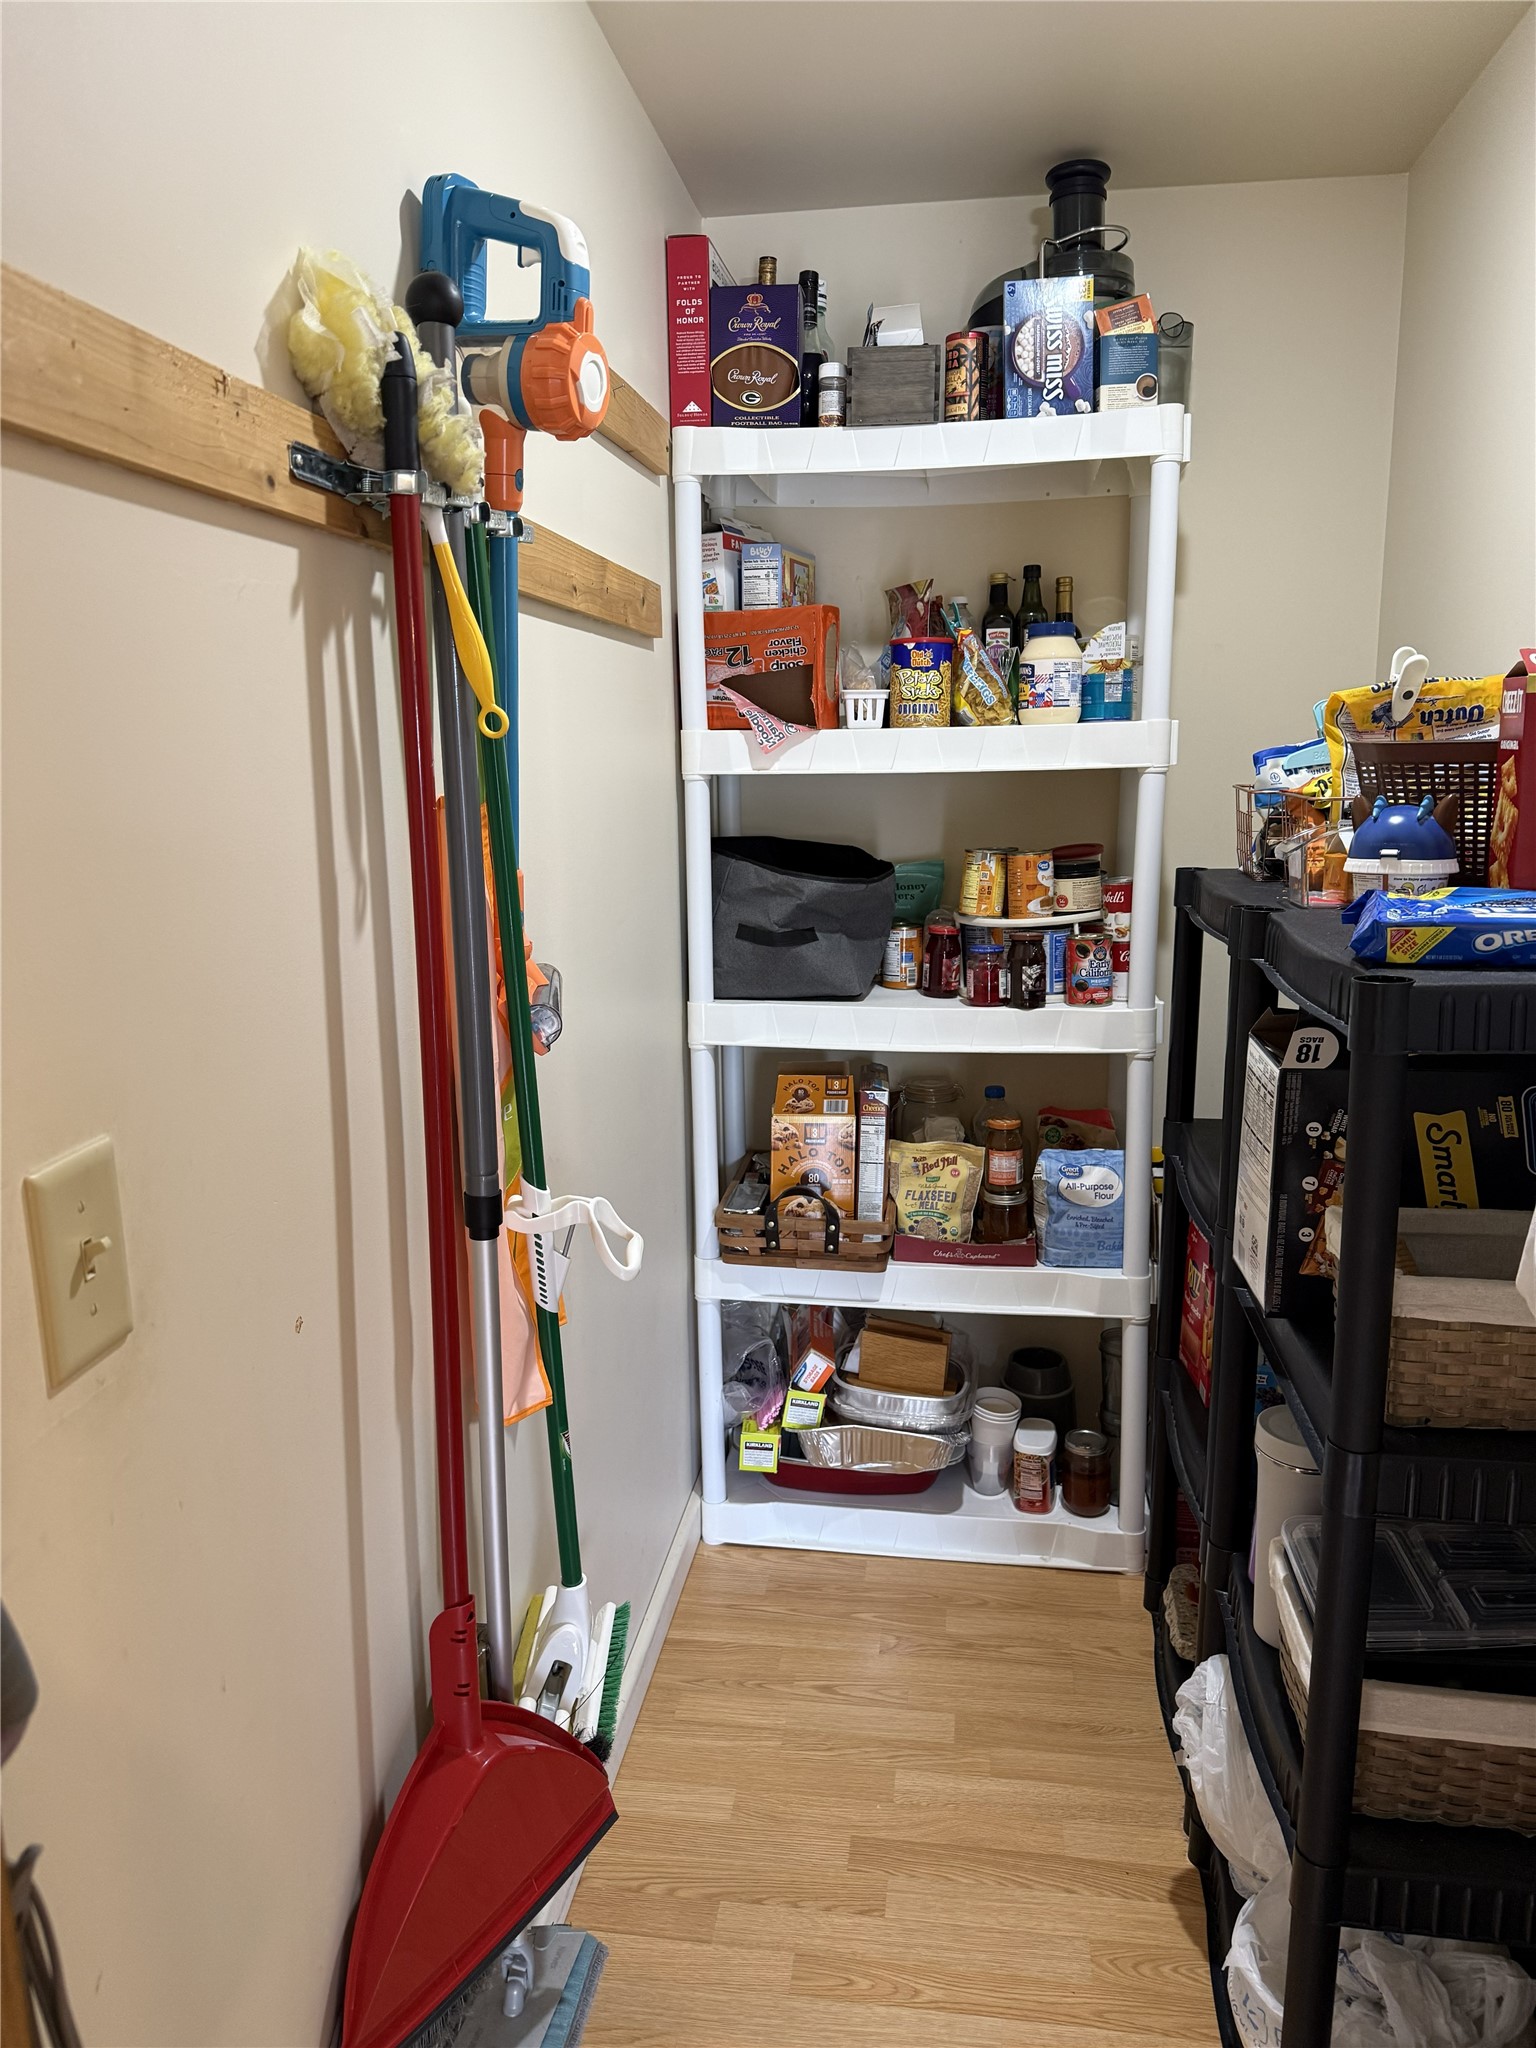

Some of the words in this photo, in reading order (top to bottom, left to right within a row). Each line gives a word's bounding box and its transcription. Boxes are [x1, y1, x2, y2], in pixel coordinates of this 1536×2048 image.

[676, 298, 703, 307] FOLDS
[685, 307, 696, 315] OF
[676, 316, 705, 325] HONOR
[728, 316, 753, 333] Crown
[745, 315, 781, 332] Royal
[1044, 294, 1064, 352] SWISS
[727, 368, 751, 383] Crown
[745, 370, 779, 386] Royal
[1042, 353, 1064, 401] MISS
[749, 545, 773, 558] BLUEY
[768, 636, 802, 647] Flavor
[725, 643, 754, 668] 12
[764, 646, 807, 658] Chicken
[910, 649, 925, 659] Old
[910, 658, 932, 667] Dutch
[896, 668, 943, 686] Potato
[901, 683, 943, 701] Sticks
[898, 703, 940, 715] ORIGINAL
[1420, 703, 1485, 726] Dutch
[1390, 930, 1418, 955] FAMILY
[1474, 929, 1536, 952] ORE
[1401, 940, 1419, 955] SIZE
[1088, 959, 1111, 969] Early
[1299, 1036, 1325, 1044] BAGS
[1295, 1043, 1323, 1064] 18
[783, 1078, 804, 1092] HALO
[807, 1079, 820, 1092] TOP
[833, 1080, 839, 1089] 3
[862, 1103, 886, 1112] Cheerios
[1500, 1100, 1513, 1112] 80
[1331, 1108, 1344, 1134] CHEDDAR
[1488, 1113, 1497, 1123] NO
[812, 1127, 818, 1138] 3
[777, 1147, 819, 1175] HALO
[827, 1150, 851, 1175] TOP
[921, 1161, 940, 1176] Red
[940, 1155, 958, 1171] Mill
[1426, 1122, 1468, 1209] Smart
[1061, 1165, 1080, 1174] Great
[808, 1173, 820, 1183] 80
[1065, 1182, 1114, 1192] All-Purpose
[904, 1189, 958, 1204] FLAXSEED
[1094, 1191, 1115, 1200] Flour
[918, 1201, 940, 1211] MEAL
[1097, 1240, 1123, 1252] Baki
[933, 1249, 954, 1258] Chef's
[964, 1251, 998, 1260] Cupboard
[803, 1363, 818, 1384] STORAGE
[791, 1399, 819, 1407] KIRKLAND
